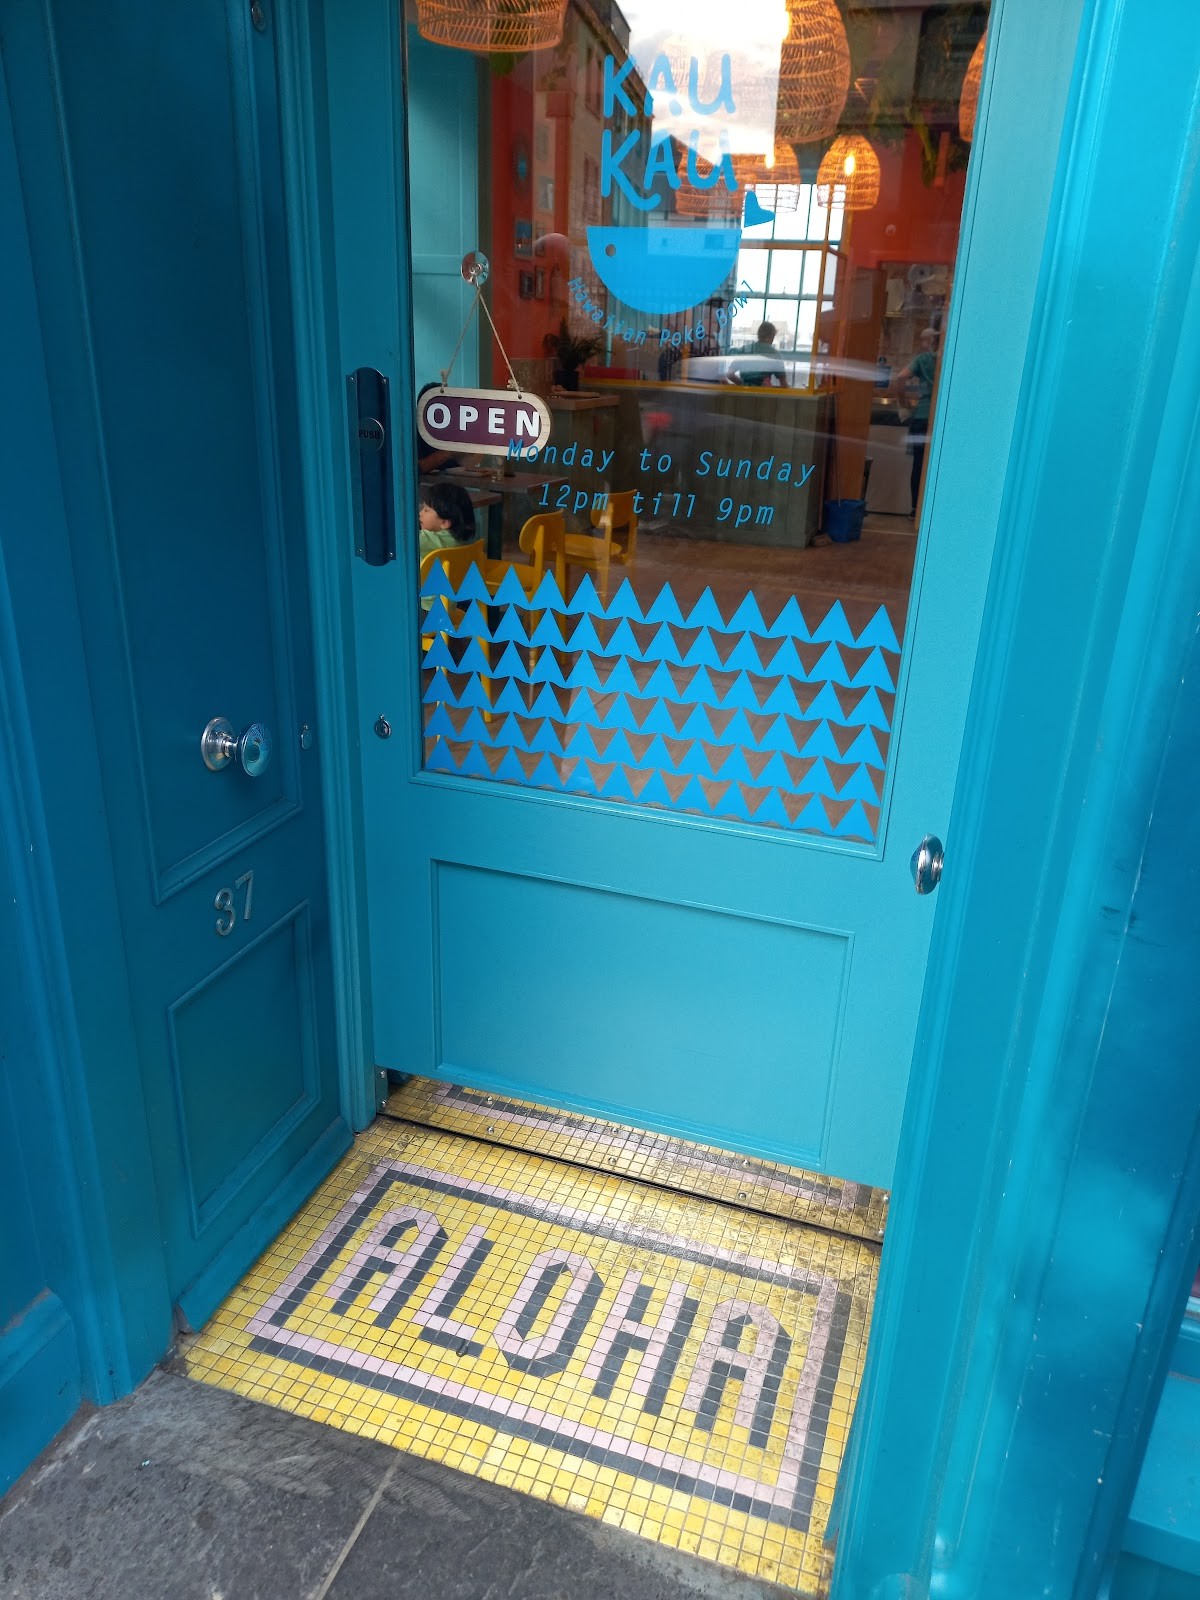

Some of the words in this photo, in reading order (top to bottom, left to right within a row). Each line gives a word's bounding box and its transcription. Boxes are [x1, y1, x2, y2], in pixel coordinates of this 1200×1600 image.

[604, 53, 736, 118] KAU
[601, 129, 738, 212] KAU
[567, 276, 647, 345] Hawaiian
[659, 320, 706, 347] Poké
[715, 280, 755, 329] Bowl
[358, 429, 380, 440] PUSH
[426, 402, 540, 437] OPEN
[506, 438, 615, 473] Monday
[640, 448, 672, 473] to
[696, 451, 816, 488] Sunday
[538, 483, 609, 513] 12pm
[633, 491, 696, 518] till
[716, 497, 775, 528] 9pm
[215, 870, 254, 936] 37
[325, 1205, 792, 1450] ALOHA
